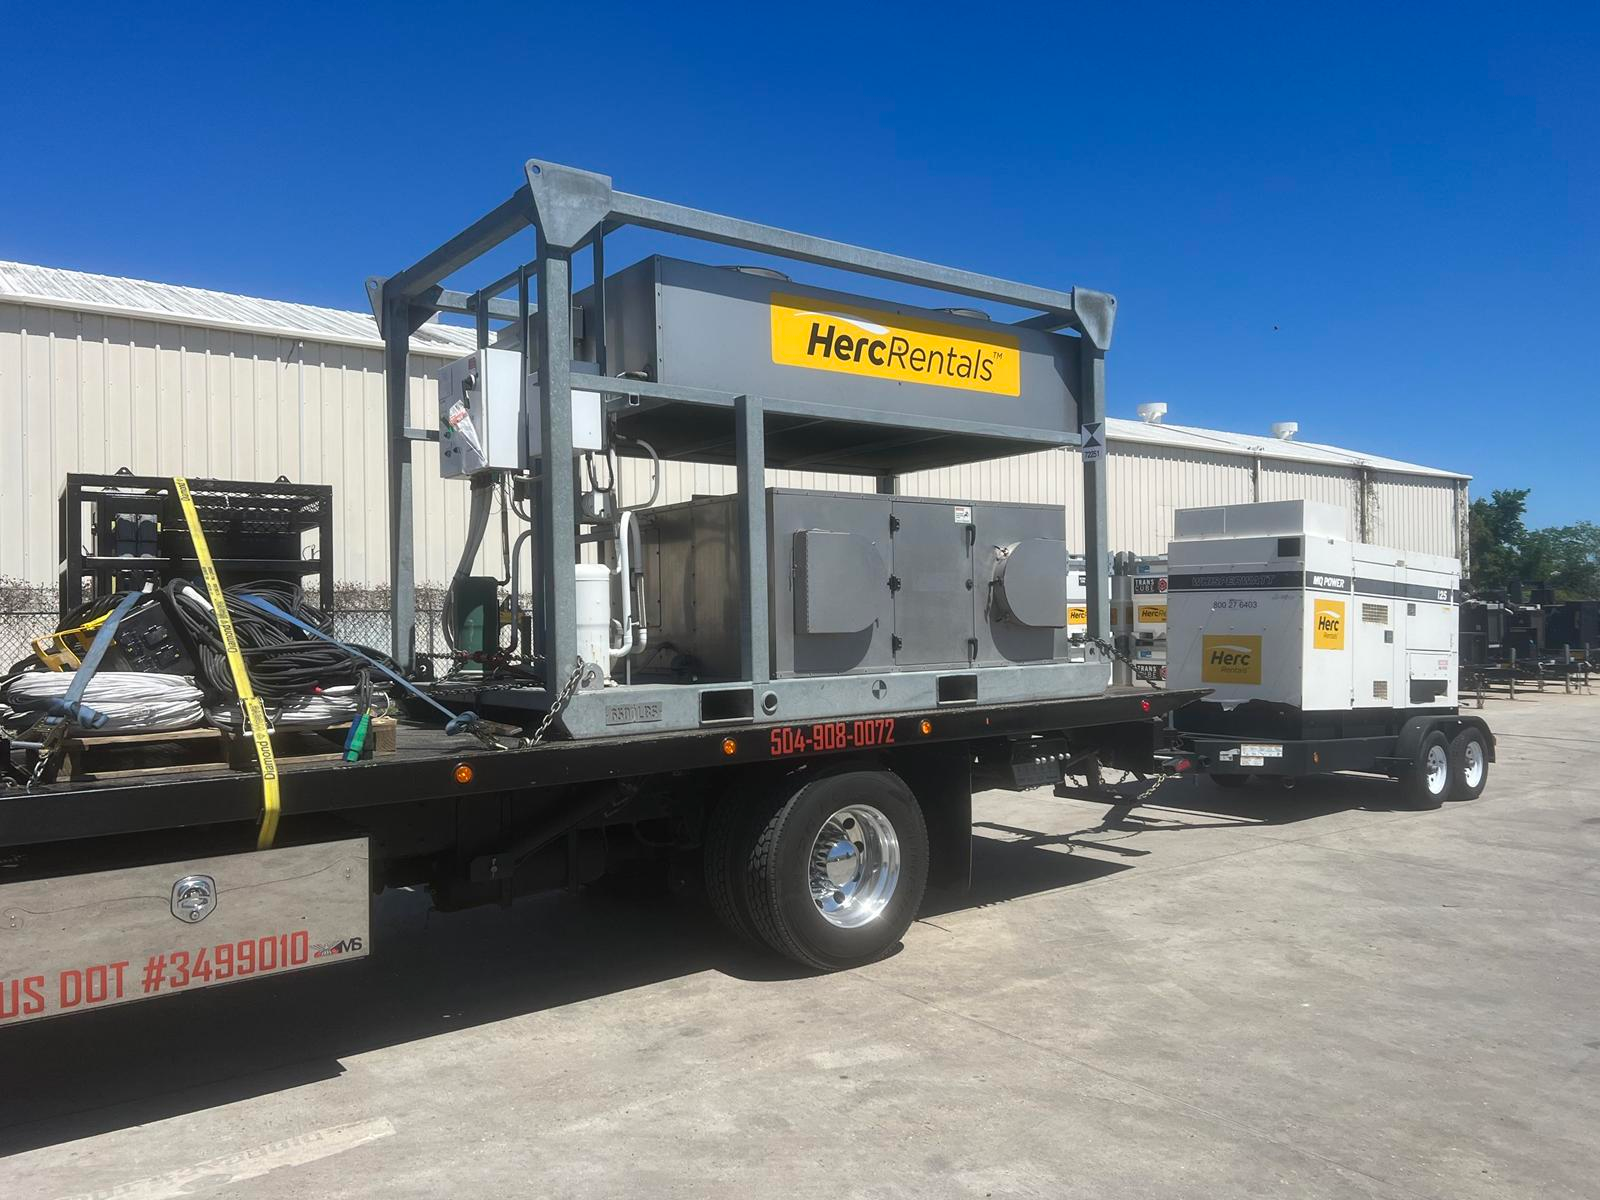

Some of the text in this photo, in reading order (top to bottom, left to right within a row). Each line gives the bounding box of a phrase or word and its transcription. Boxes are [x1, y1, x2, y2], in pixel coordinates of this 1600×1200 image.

[807, 322, 994, 382] HercRentals
[1312, 575, 1345, 589] MQ POWER
[1437, 589, 1448, 601] 125
[1317, 615, 1340, 632] Herc
[1210, 650, 1251, 666] Herc
[770, 718, 895, 756] 504-908-0072
[256, 740, 276, 780] Diamond
[0, 930, 309, 1019] US DOT #3499010
